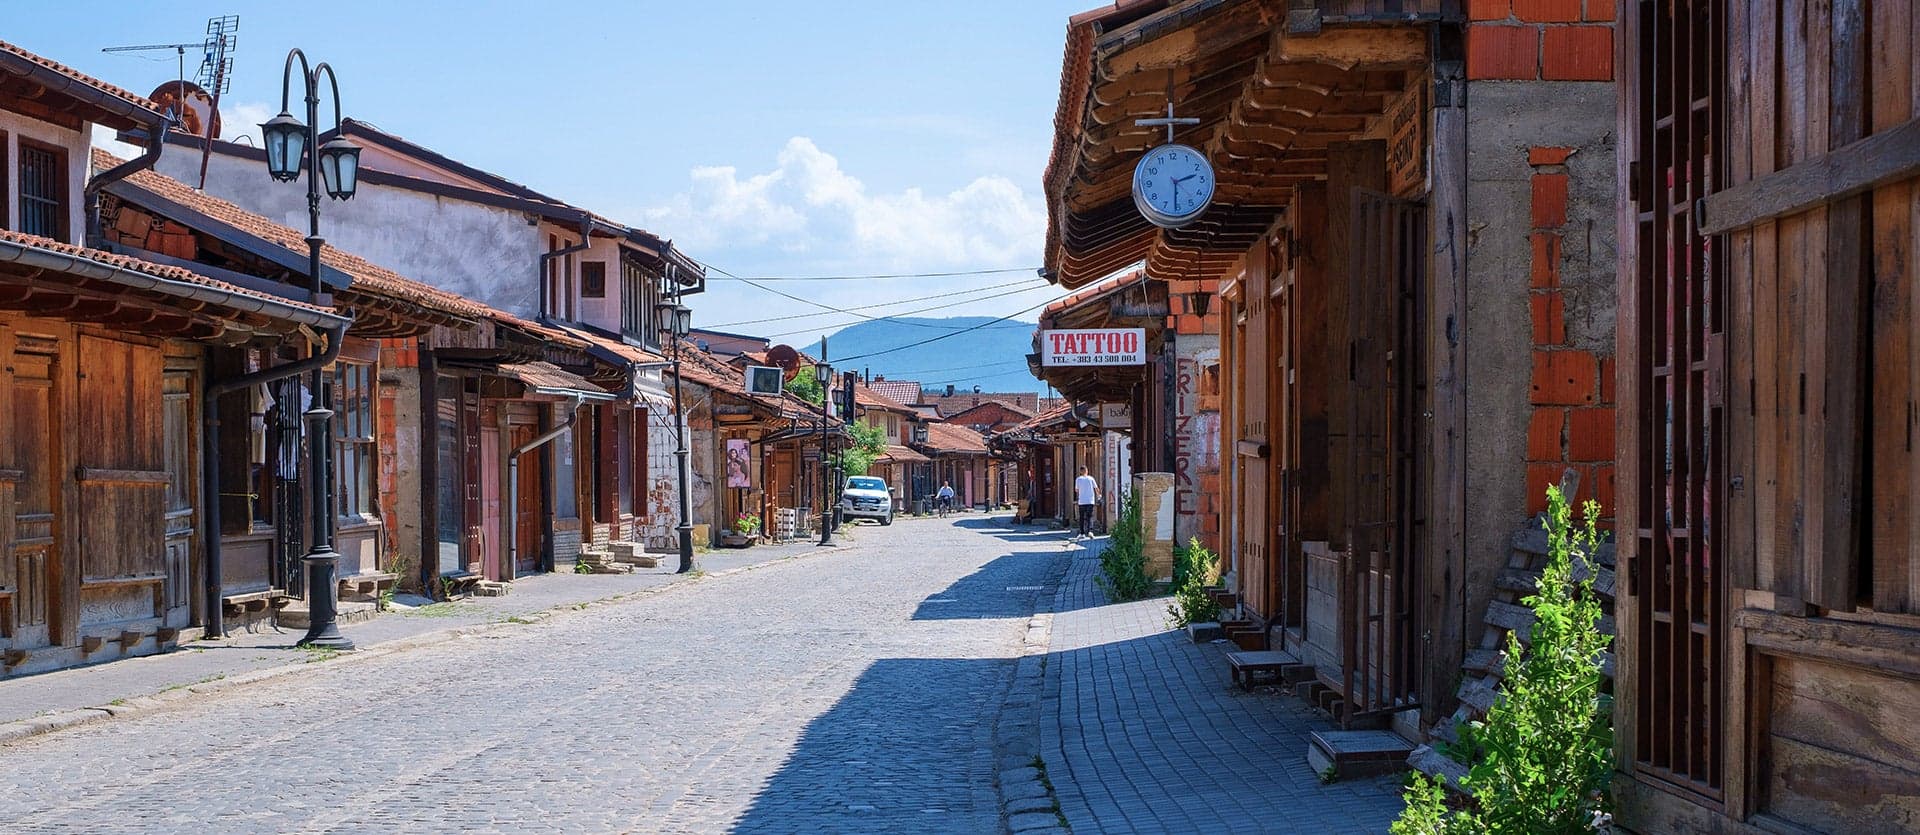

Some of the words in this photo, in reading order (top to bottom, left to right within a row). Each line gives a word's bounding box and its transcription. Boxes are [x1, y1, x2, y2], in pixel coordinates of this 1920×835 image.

[1157, 157, 1165, 165] 11
[1148, 167, 1158, 175] 10
[1194, 163, 1201, 171] 2
[1199, 175, 1206, 183] 3
[1146, 180, 1153, 188] 9
[1151, 192, 1158, 200] 8
[1187, 199, 1194, 207] 5
[1049, 332, 1138, 354] TATTOO
[1094, 355, 1103, 363] 43
